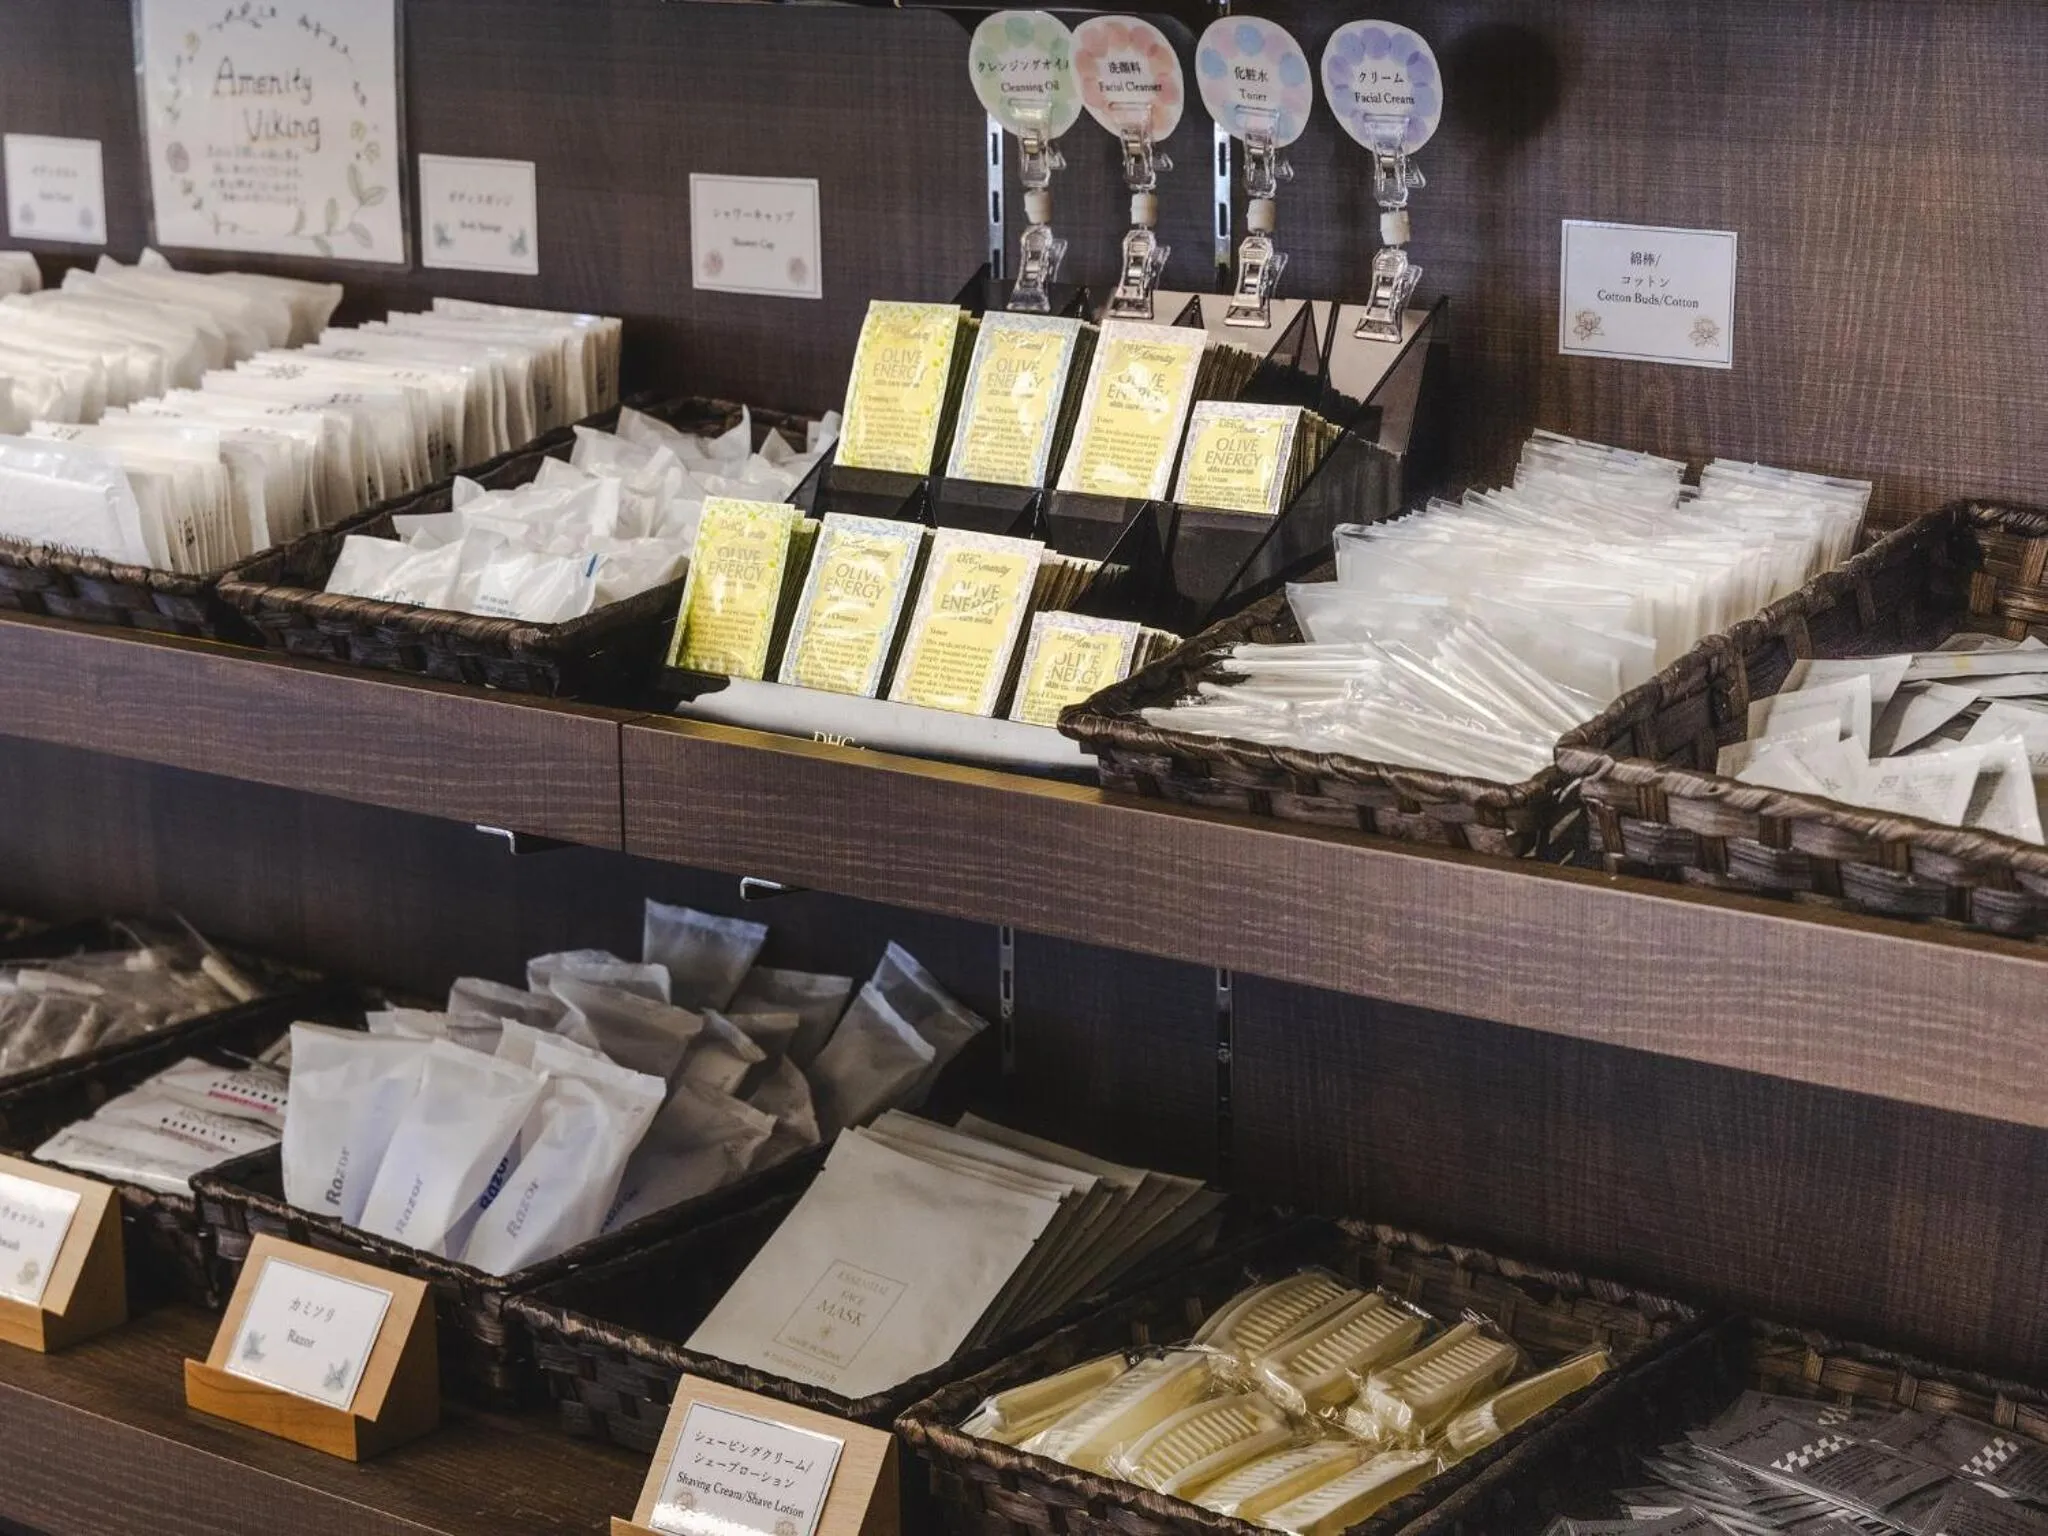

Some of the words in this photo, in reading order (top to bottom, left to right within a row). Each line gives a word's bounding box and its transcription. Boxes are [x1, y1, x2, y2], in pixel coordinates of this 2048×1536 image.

[1108, 61, 1141, 74] 洗顔料
[1234, 66, 1269, 83] 化粧水
[1358, 71, 1406, 84] クリーム
[211, 55, 313, 105] Amenity
[1001, 80, 1044, 93] Cleansing
[1045, 79, 1060, 91] Oil
[1098, 81, 1124, 92] Facial
[1125, 81, 1163, 92] Cleanser
[1239, 88, 1268, 102] Toner
[1354, 91, 1382, 104] Facial
[1383, 93, 1416, 105] Cream
[242, 108, 322, 153] Viking
[1621, 275, 1671, 288] コットン
[1597, 289, 1632, 303] Cotton
[1634, 293, 1699, 309] Buds/Cotton
[1215, 437, 1260, 453] OLIVE
[1204, 451, 1264, 468] ENERGY
[707, 561, 765, 582] ENERGY
[325, 1145, 351, 1206] Razor
[394, 1173, 425, 1235] Razor
[505, 1177, 541, 1240] Razor
[288, 1296, 337, 1323] カミソリ
[816, 1297, 867, 1327] MASK
[286, 1328, 316, 1350] Razor
[692, 1451, 798, 1489] シェーブローション
[676, 1470, 712, 1494] Shaving
[713, 1483, 774, 1511] Cream/Shave
[773, 1499, 806, 1519] Lotion
